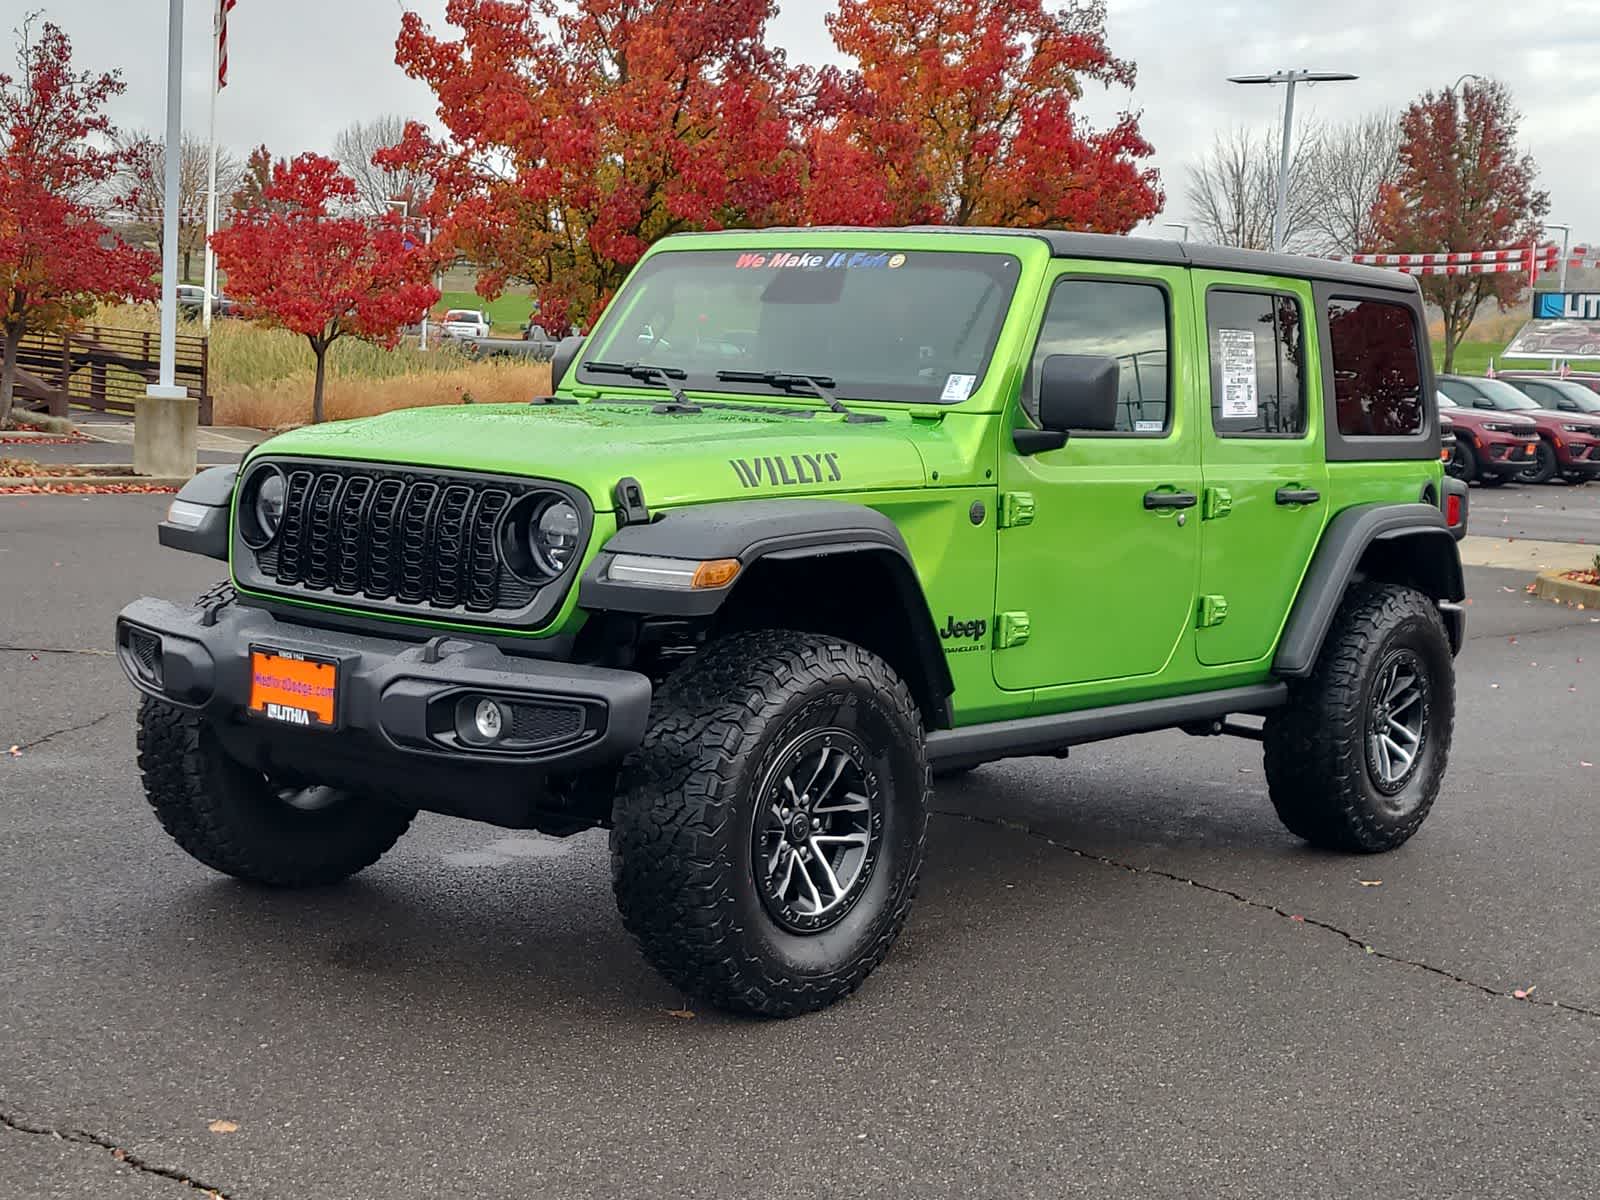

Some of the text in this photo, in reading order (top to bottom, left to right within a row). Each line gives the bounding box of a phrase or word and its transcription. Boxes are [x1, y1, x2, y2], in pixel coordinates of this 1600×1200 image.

[736, 253, 766, 268] We
[768, 252, 824, 268] Make
[826, 253, 847, 268] It
[729, 453, 842, 488] WILLYS
[940, 616, 986, 641] Jeep
[277, 704, 309, 725] LITHIA
